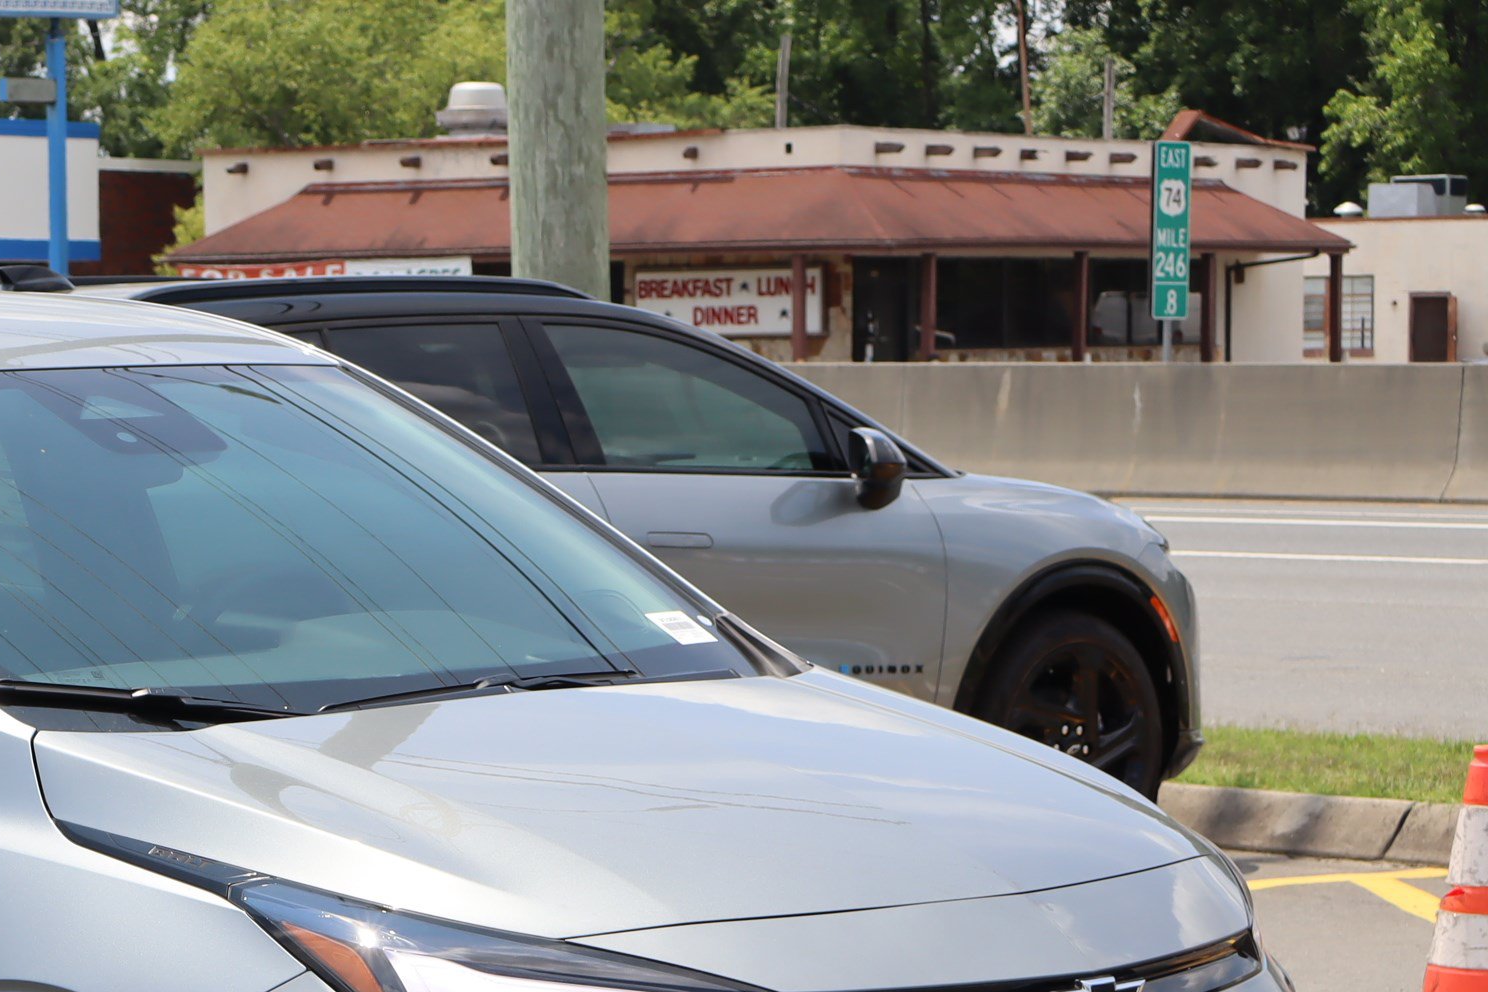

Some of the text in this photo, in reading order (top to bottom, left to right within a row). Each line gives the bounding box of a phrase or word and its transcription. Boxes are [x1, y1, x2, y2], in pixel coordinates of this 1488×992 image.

[1159, 147, 1186, 169] EAST
[1164, 187, 1182, 208] 74
[1157, 228, 1187, 248] MILE
[1155, 252, 1187, 279] 246
[638, 275, 816, 299] BREAKFAST LUNH
[692, 306, 758, 327] DINNER
